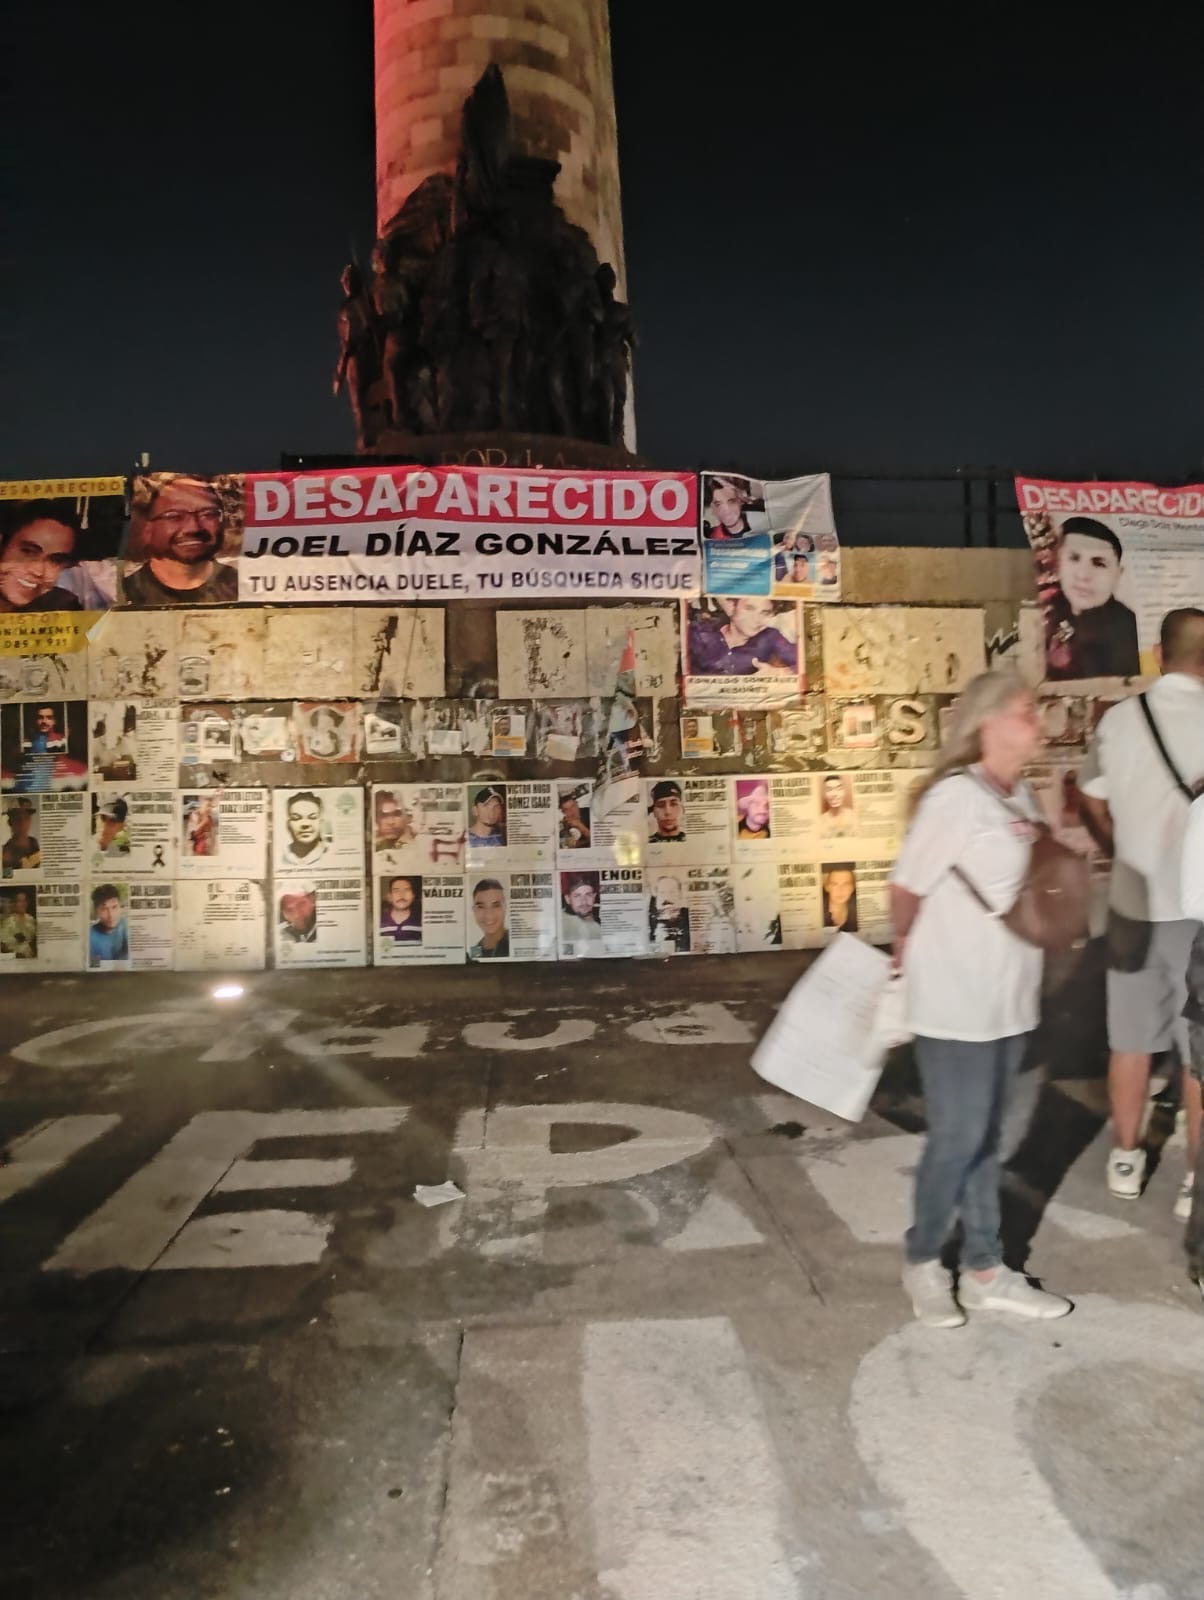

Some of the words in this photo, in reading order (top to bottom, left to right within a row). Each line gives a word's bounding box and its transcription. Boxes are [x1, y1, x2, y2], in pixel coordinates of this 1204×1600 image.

[0, 479, 121, 496] ESAPARECIDO
[253, 472, 689, 521] DESAPARECIDO
[1022, 484, 1204, 516] DESAPARECID
[244, 534, 350, 558] JOEL
[365, 523, 460, 557] DÍAZ
[475, 530, 698, 556] GONZÁLEZ
[249, 576, 276, 592] TU
[284, 574, 390, 592] AUSENCIA
[397, 573, 470, 593] DUELE,
[476, 572, 503, 589] TU
[511, 568, 623, 589] BÚSQUEDA
[631, 572, 693, 590] SIGUE
[601, 869, 642, 881] ENOC
